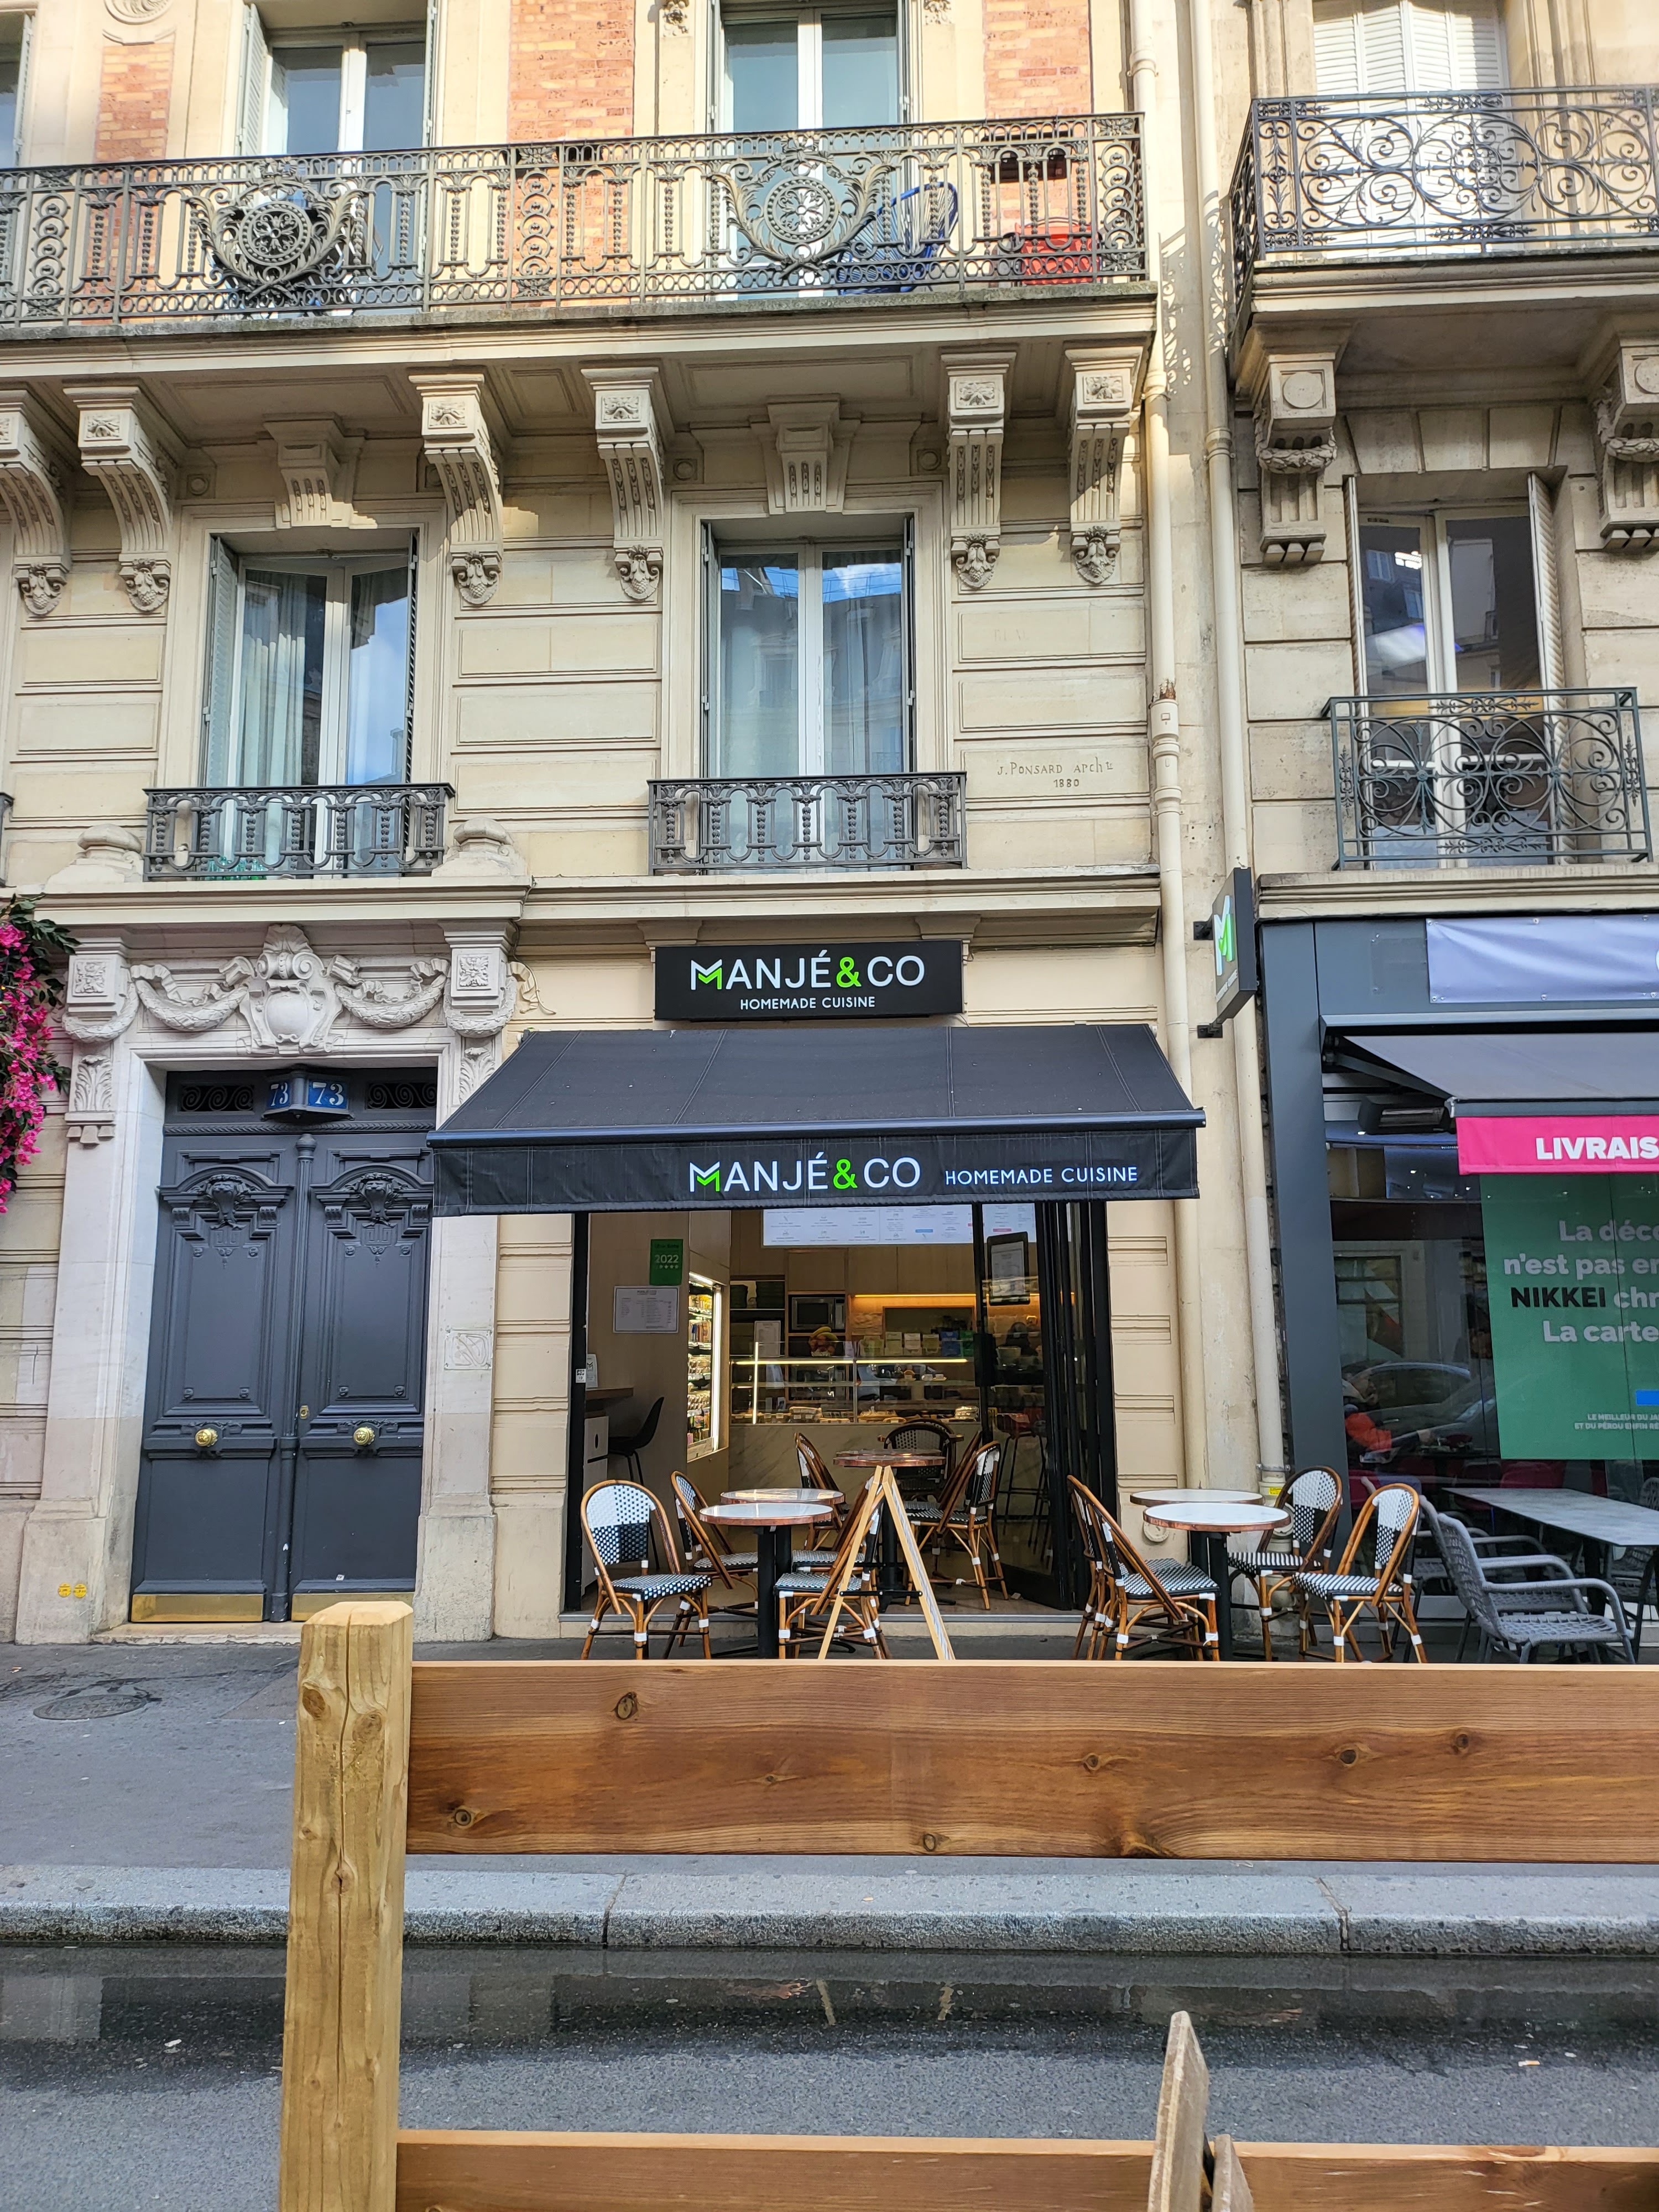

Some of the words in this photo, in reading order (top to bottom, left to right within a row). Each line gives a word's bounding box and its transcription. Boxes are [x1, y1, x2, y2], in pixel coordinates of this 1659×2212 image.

[1053, 779, 1079, 787] 1880
[740, 998, 816, 1010] HOMEMADE
[822, 997, 875, 1008] CUISINE
[270, 1082, 288, 1106] 73
[312, 1082, 344, 1105] 73
[1536, 1136, 1659, 1160] LIVRAIS
[945, 1168, 1052, 1185] HOMEMADE
[1061, 1166, 1137, 1182] CUISINE
[1559, 1220, 1593, 1241] La
[655, 1254, 679, 1264] 2022
[1504, 1253, 1569, 1275] n'est
[1576, 1258, 1625, 1280] pas
[1511, 1287, 1606, 1307] NIKKEI
[1543, 1320, 1577, 1342] La
[1584, 1322, 1659, 1342] carte
